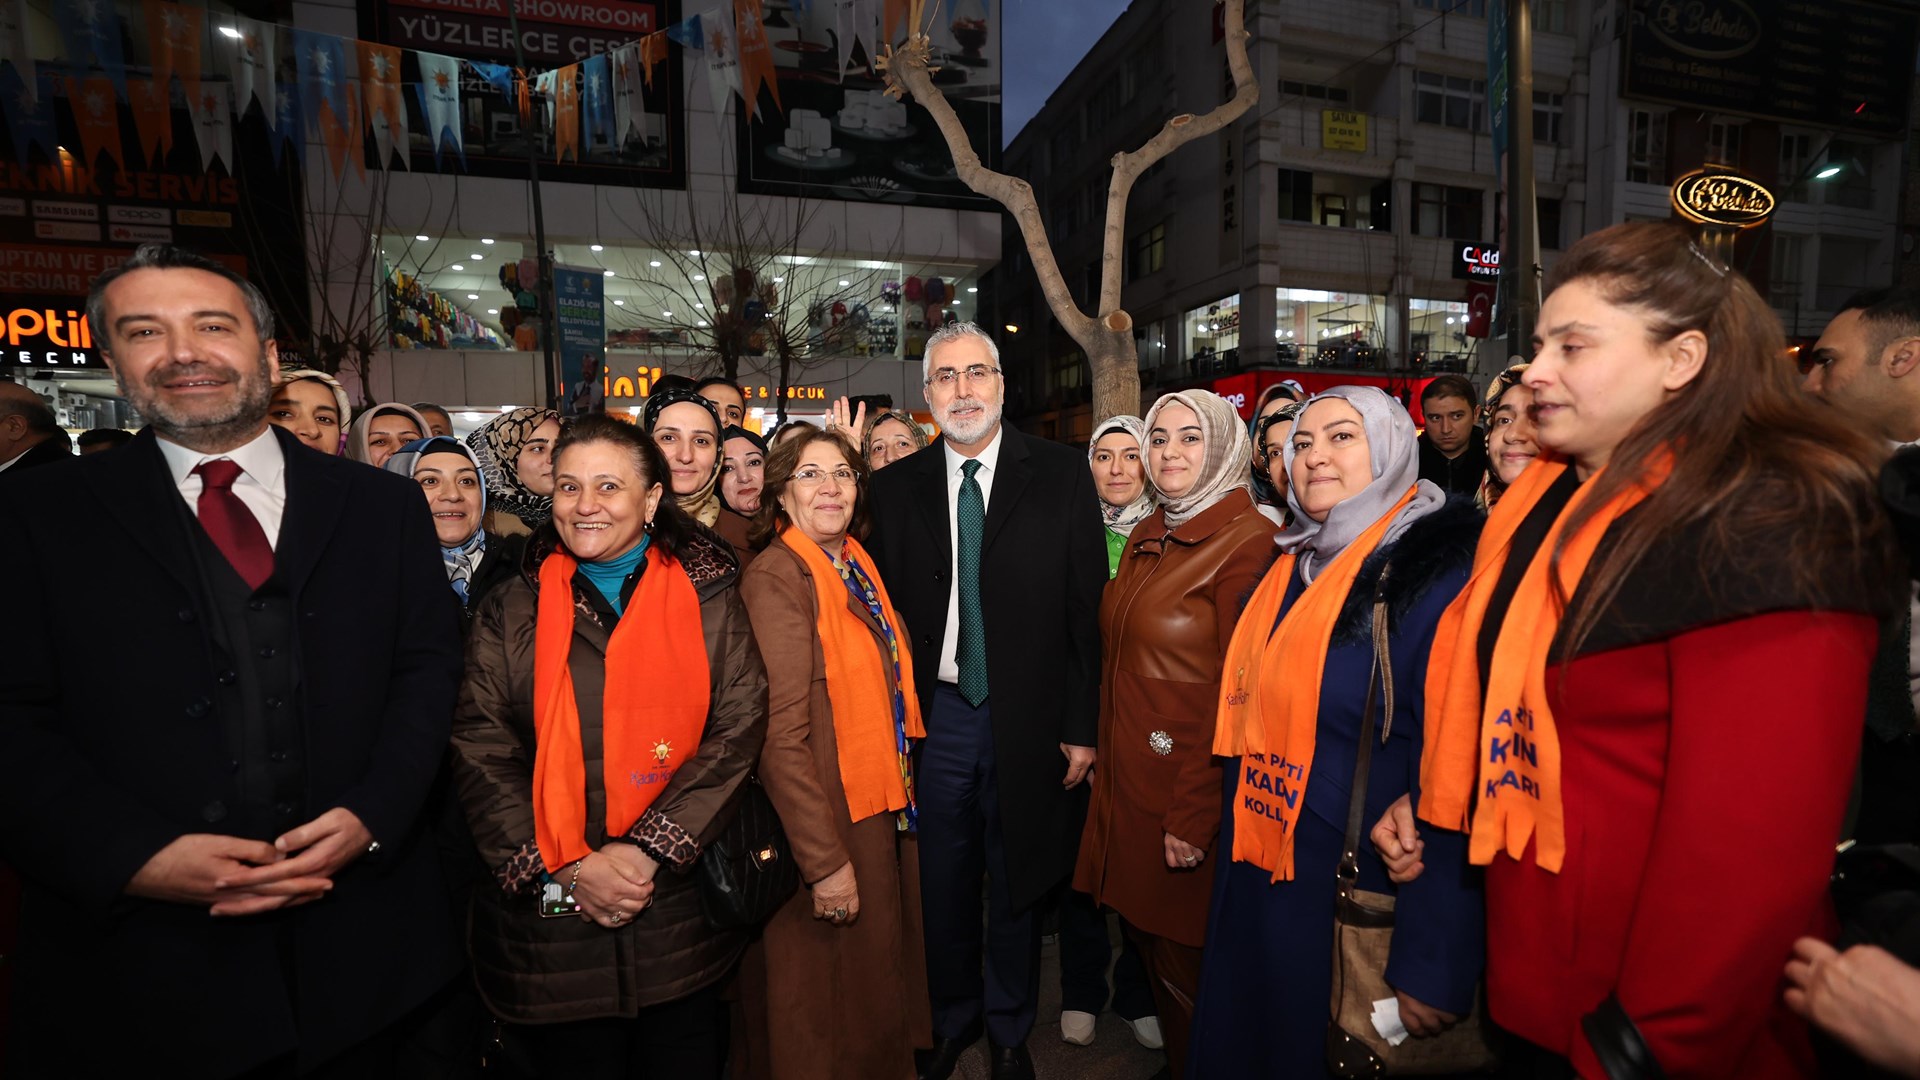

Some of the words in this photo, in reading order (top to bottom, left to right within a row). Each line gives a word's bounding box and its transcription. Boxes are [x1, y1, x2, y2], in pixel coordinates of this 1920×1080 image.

[513, 0, 648, 28] SHOWROOM
[398, 15, 559, 54] YÜZLERCE
[114, 172, 240, 206] SERVİS
[35, 205, 96, 217] SAMSUNG
[68, 253, 97, 271] VE
[0, 308, 92, 348] pti
